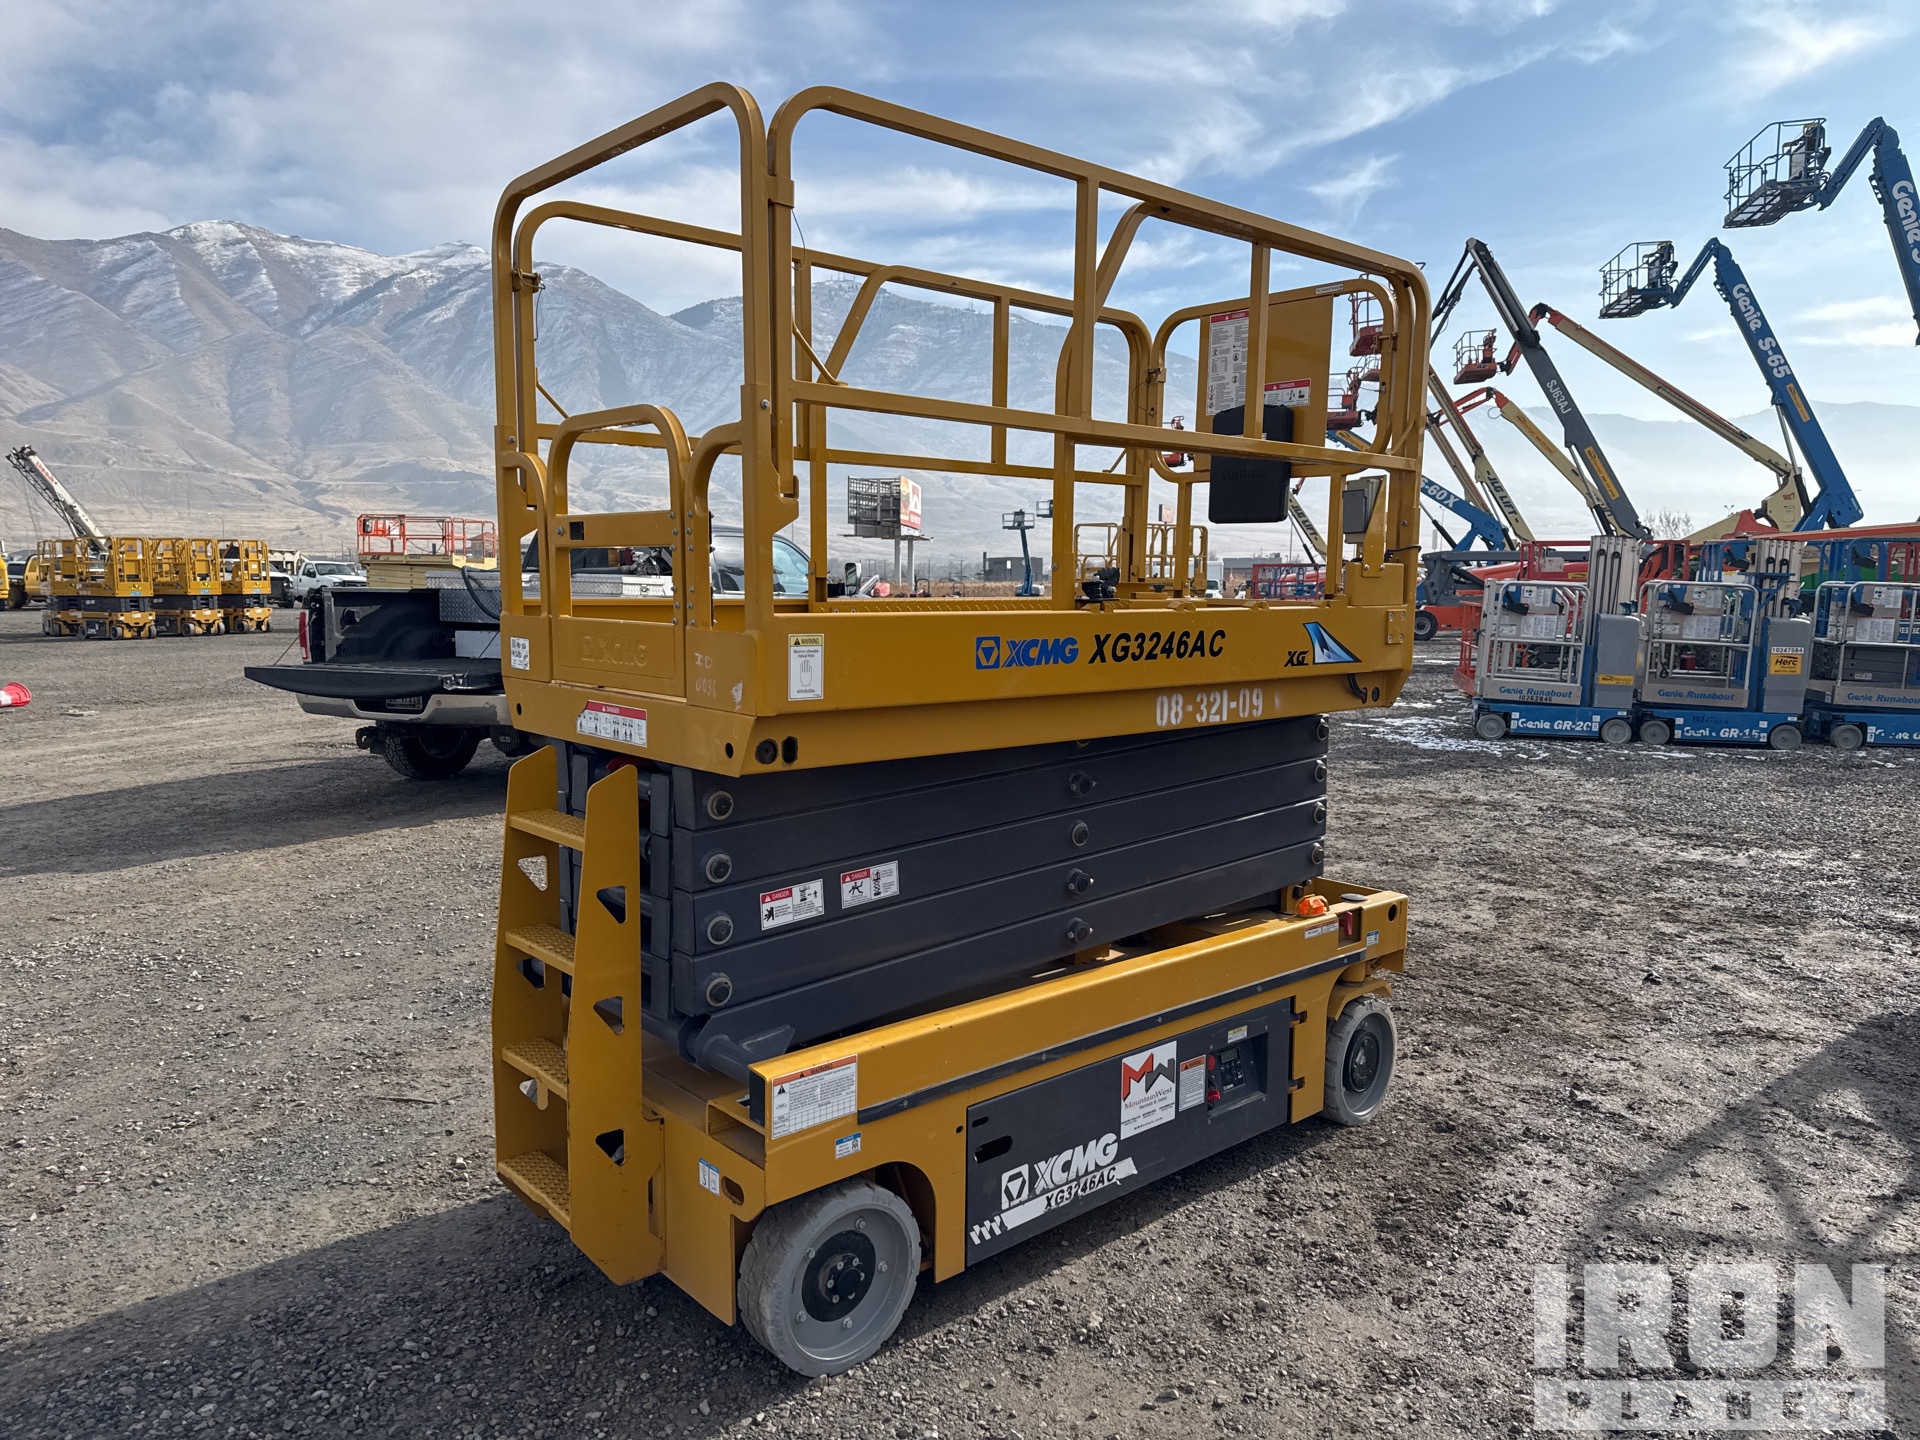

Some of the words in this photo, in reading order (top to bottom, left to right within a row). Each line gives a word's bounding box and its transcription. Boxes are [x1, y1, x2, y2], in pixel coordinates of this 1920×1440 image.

[1732, 283, 1762, 332] Genie
[1758, 337, 1791, 378] S-65
[1546, 379, 1572, 415] SJ63AJ
[1487, 476, 1503, 492] JLG
[1499, 495, 1517, 518] LIFT
[1291, 504, 1306, 518] JLG
[1301, 520, 1318, 536] LIFT
[1001, 636, 1079, 668] XCMG
[1088, 629, 1226, 665] XG3246AC
[1775, 658, 1798, 666] Herc
[1499, 686, 1524, 695] Genie
[1526, 687, 1573, 698] Runabout
[1658, 689, 1683, 698] Genie
[1687, 690, 1735, 701] Runabout
[1847, 692, 1873, 701] Genie
[1876, 694, 1920, 704] Runabou
[606, 705, 620, 714] DANGER
[1156, 687, 1263, 727] 08-321-09
[1517, 718, 1551, 729] Genie
[1683, 727, 1717, 738] Geni
[851, 870, 868, 880] DANGER
[772, 890, 790, 900] DANGER
[810, 1062, 833, 1075] WARNING
[1124, 1086, 1173, 1110] MountainWest
[1034, 1132, 1119, 1195] XCMG
